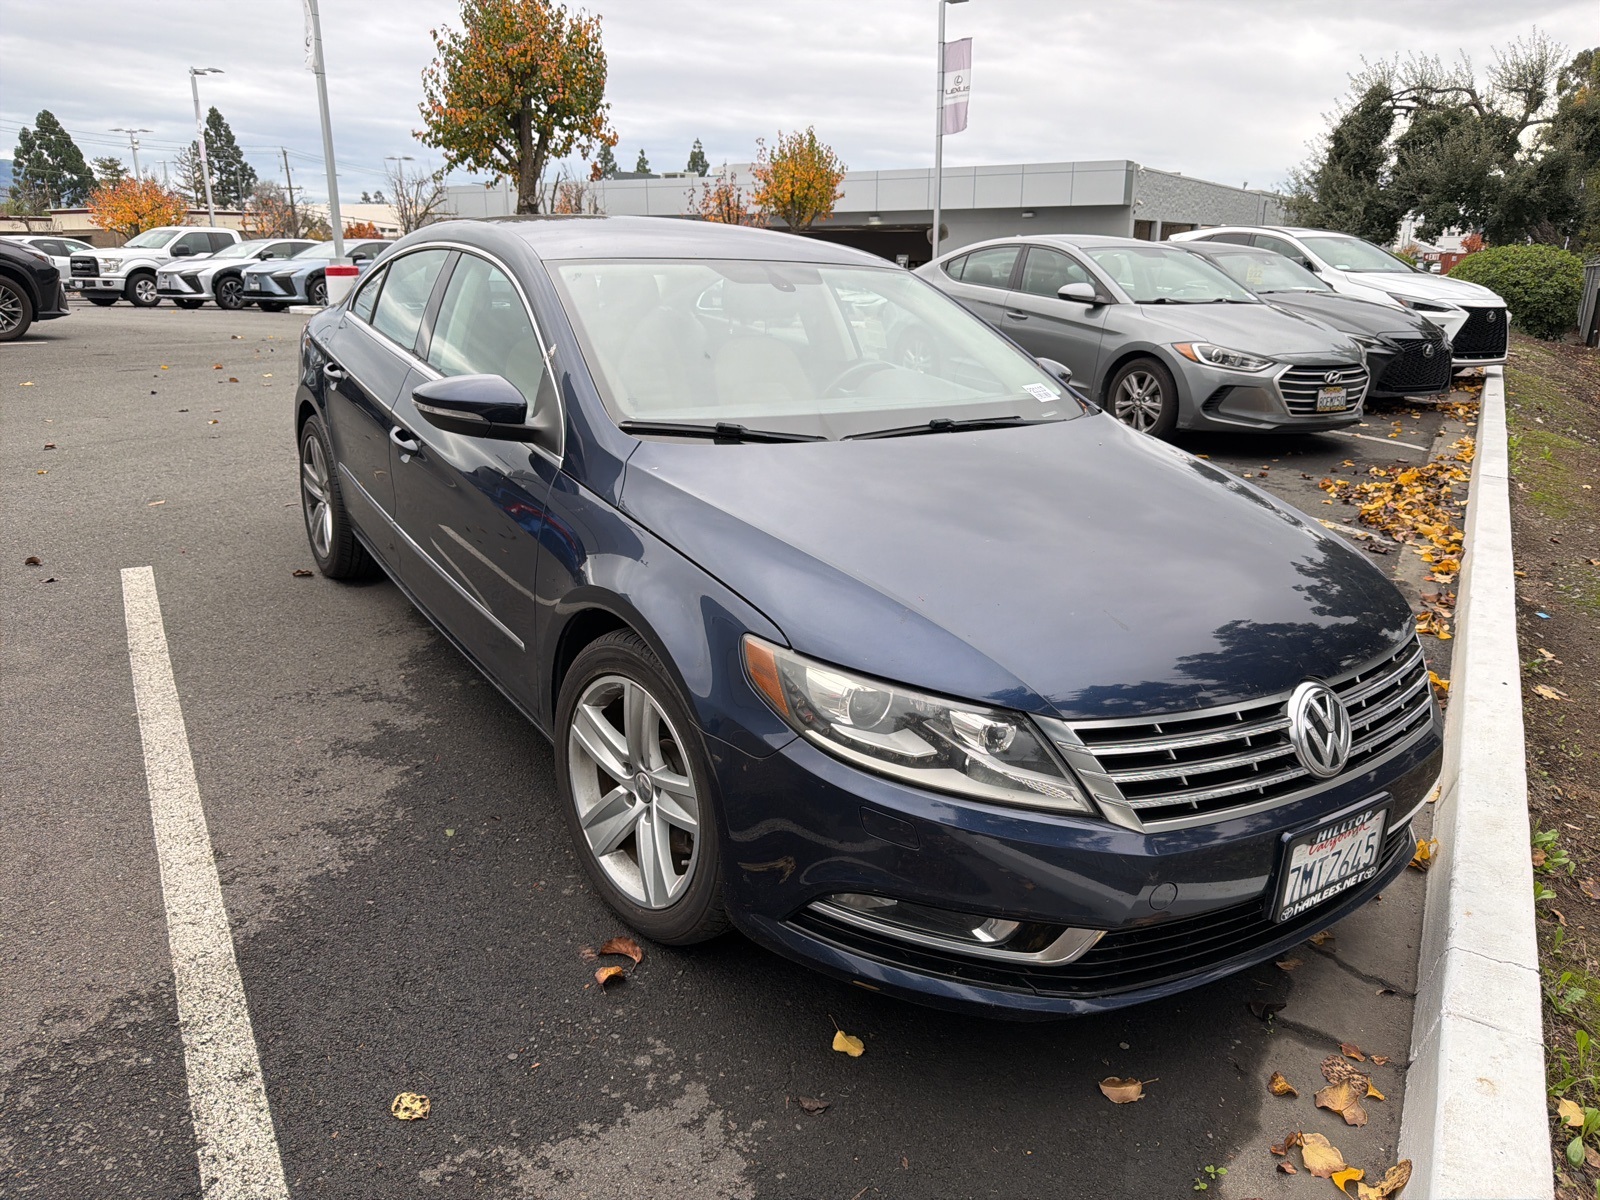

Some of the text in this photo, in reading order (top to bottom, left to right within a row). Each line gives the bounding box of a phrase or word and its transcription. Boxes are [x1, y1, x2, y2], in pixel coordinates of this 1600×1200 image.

[945, 85, 970, 95] LEXUS
[1316, 810, 1373, 843] HILLTOP
[1289, 832, 1376, 904] 7MTZ645
